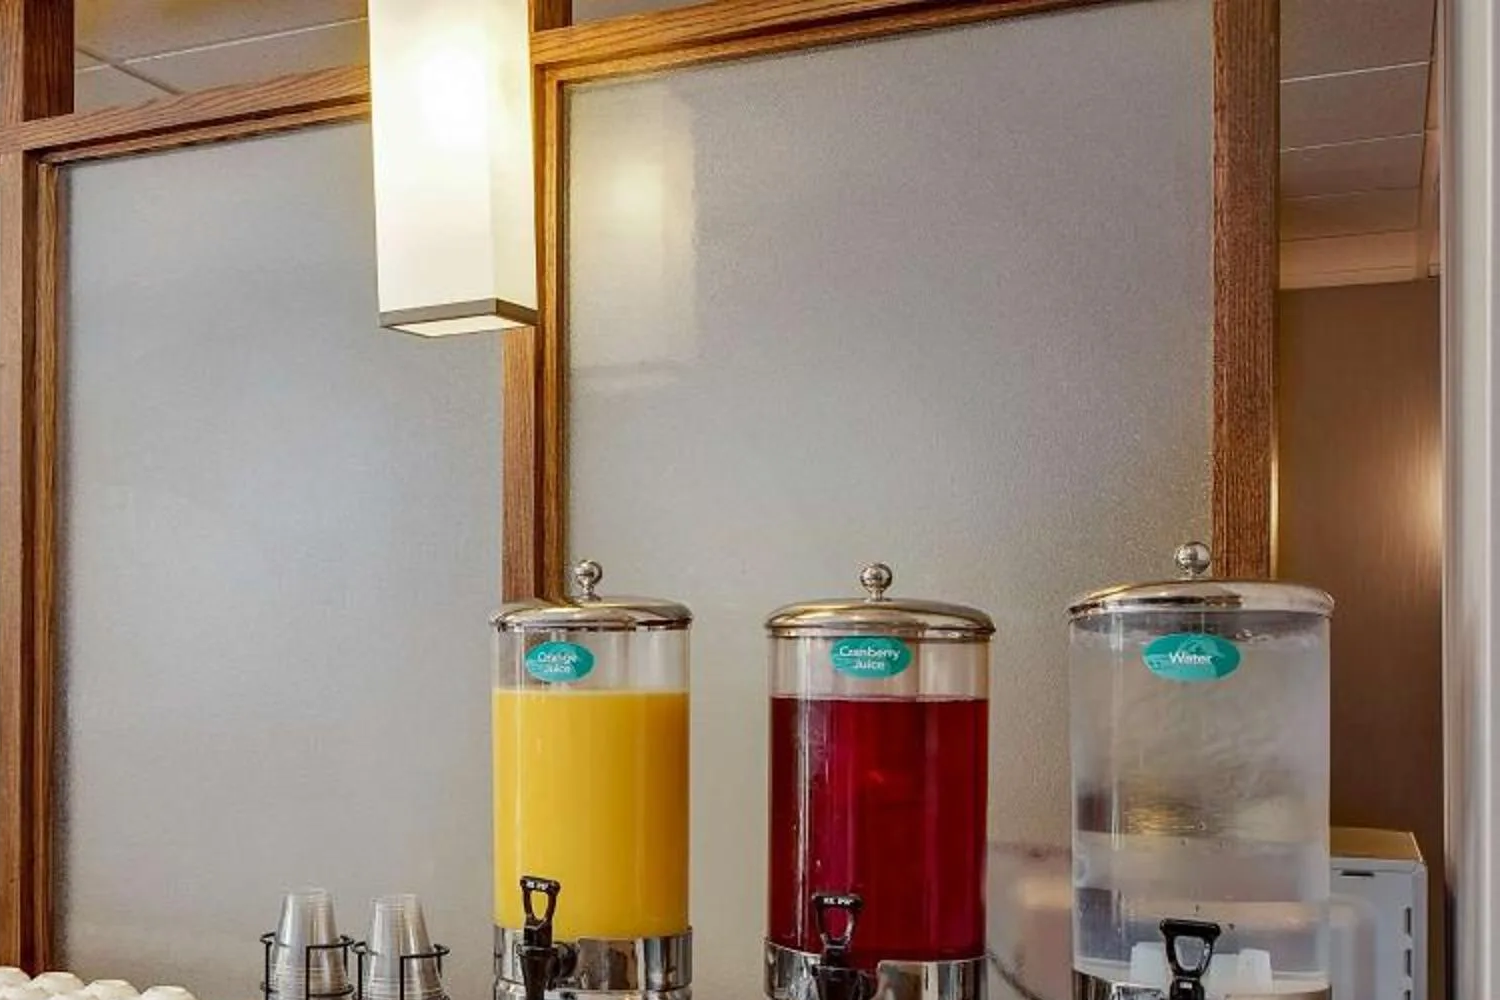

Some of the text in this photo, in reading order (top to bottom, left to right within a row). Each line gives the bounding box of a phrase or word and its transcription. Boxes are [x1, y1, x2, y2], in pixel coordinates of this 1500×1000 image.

[537, 651, 577, 665] Orange
[839, 645, 900, 661] Cranberry
[1169, 651, 1213, 665] Water
[853, 660, 886, 670] Juice
